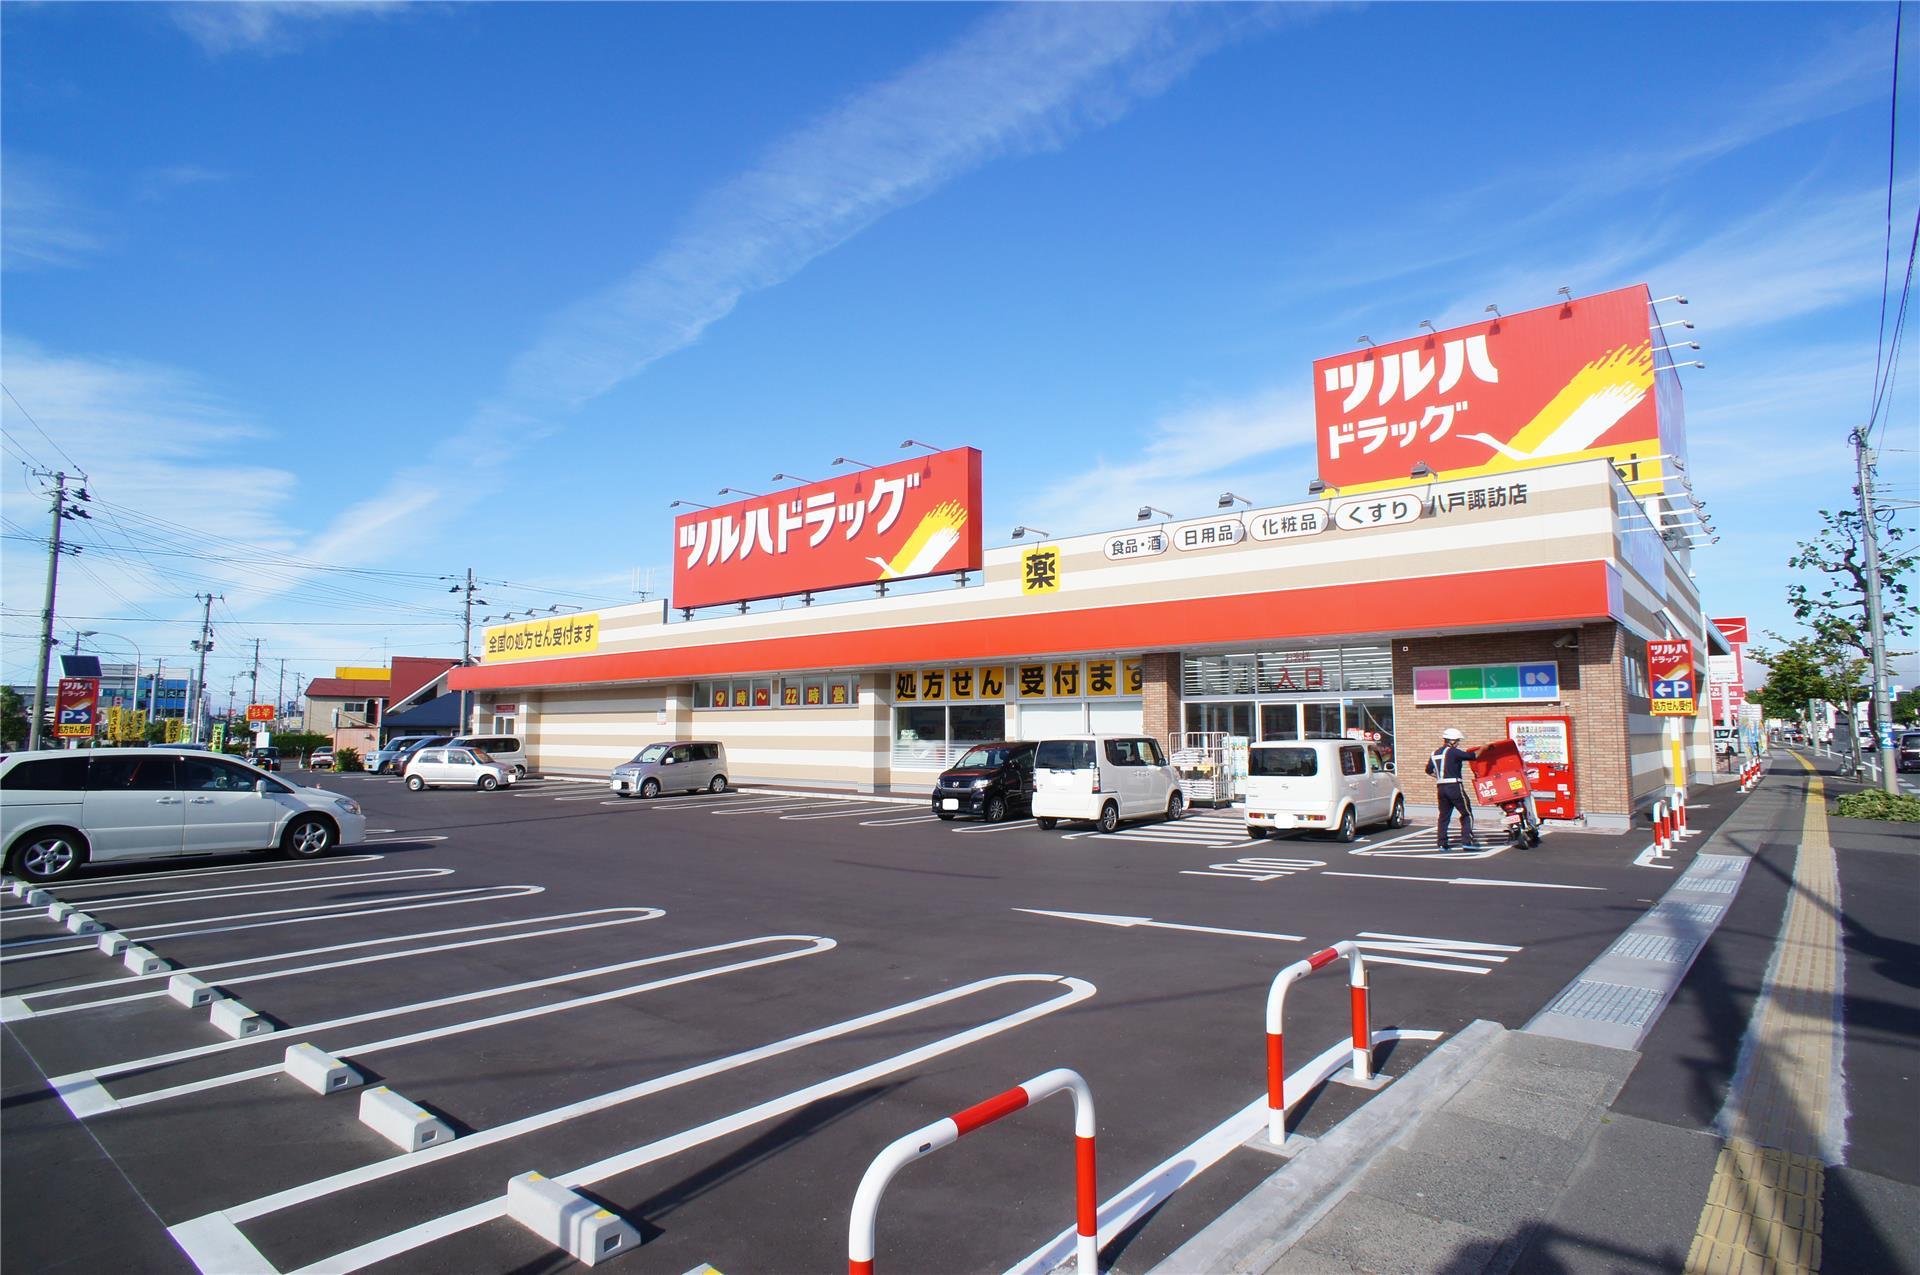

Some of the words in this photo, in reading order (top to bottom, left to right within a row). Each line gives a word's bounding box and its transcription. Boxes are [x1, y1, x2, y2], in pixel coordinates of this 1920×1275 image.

[1325, 335, 1498, 413] ツルハ
[1328, 401, 1468, 460] ドラッグ
[1429, 483, 1528, 515] 八戸諏訪店
[679, 472, 920, 569] ツルハドラッグ
[1348, 501, 1408, 525] くすり
[1184, 524, 1233, 546] 日用品
[1261, 514, 1317, 537] 化粧品
[1111, 534, 1162, 556] 食品・酒
[1026, 552, 1055, 590] 薬
[488, 624, 594, 653] 全国の処方せん受付ます
[1650, 644, 1688, 655] ツルハ
[62, 682, 93, 690] ツルハ
[1276, 668, 1323, 688] 入口
[1674, 681, 1689, 698] P
[61, 711, 75, 723] P
[1654, 701, 1692, 711] 処方せん受付
